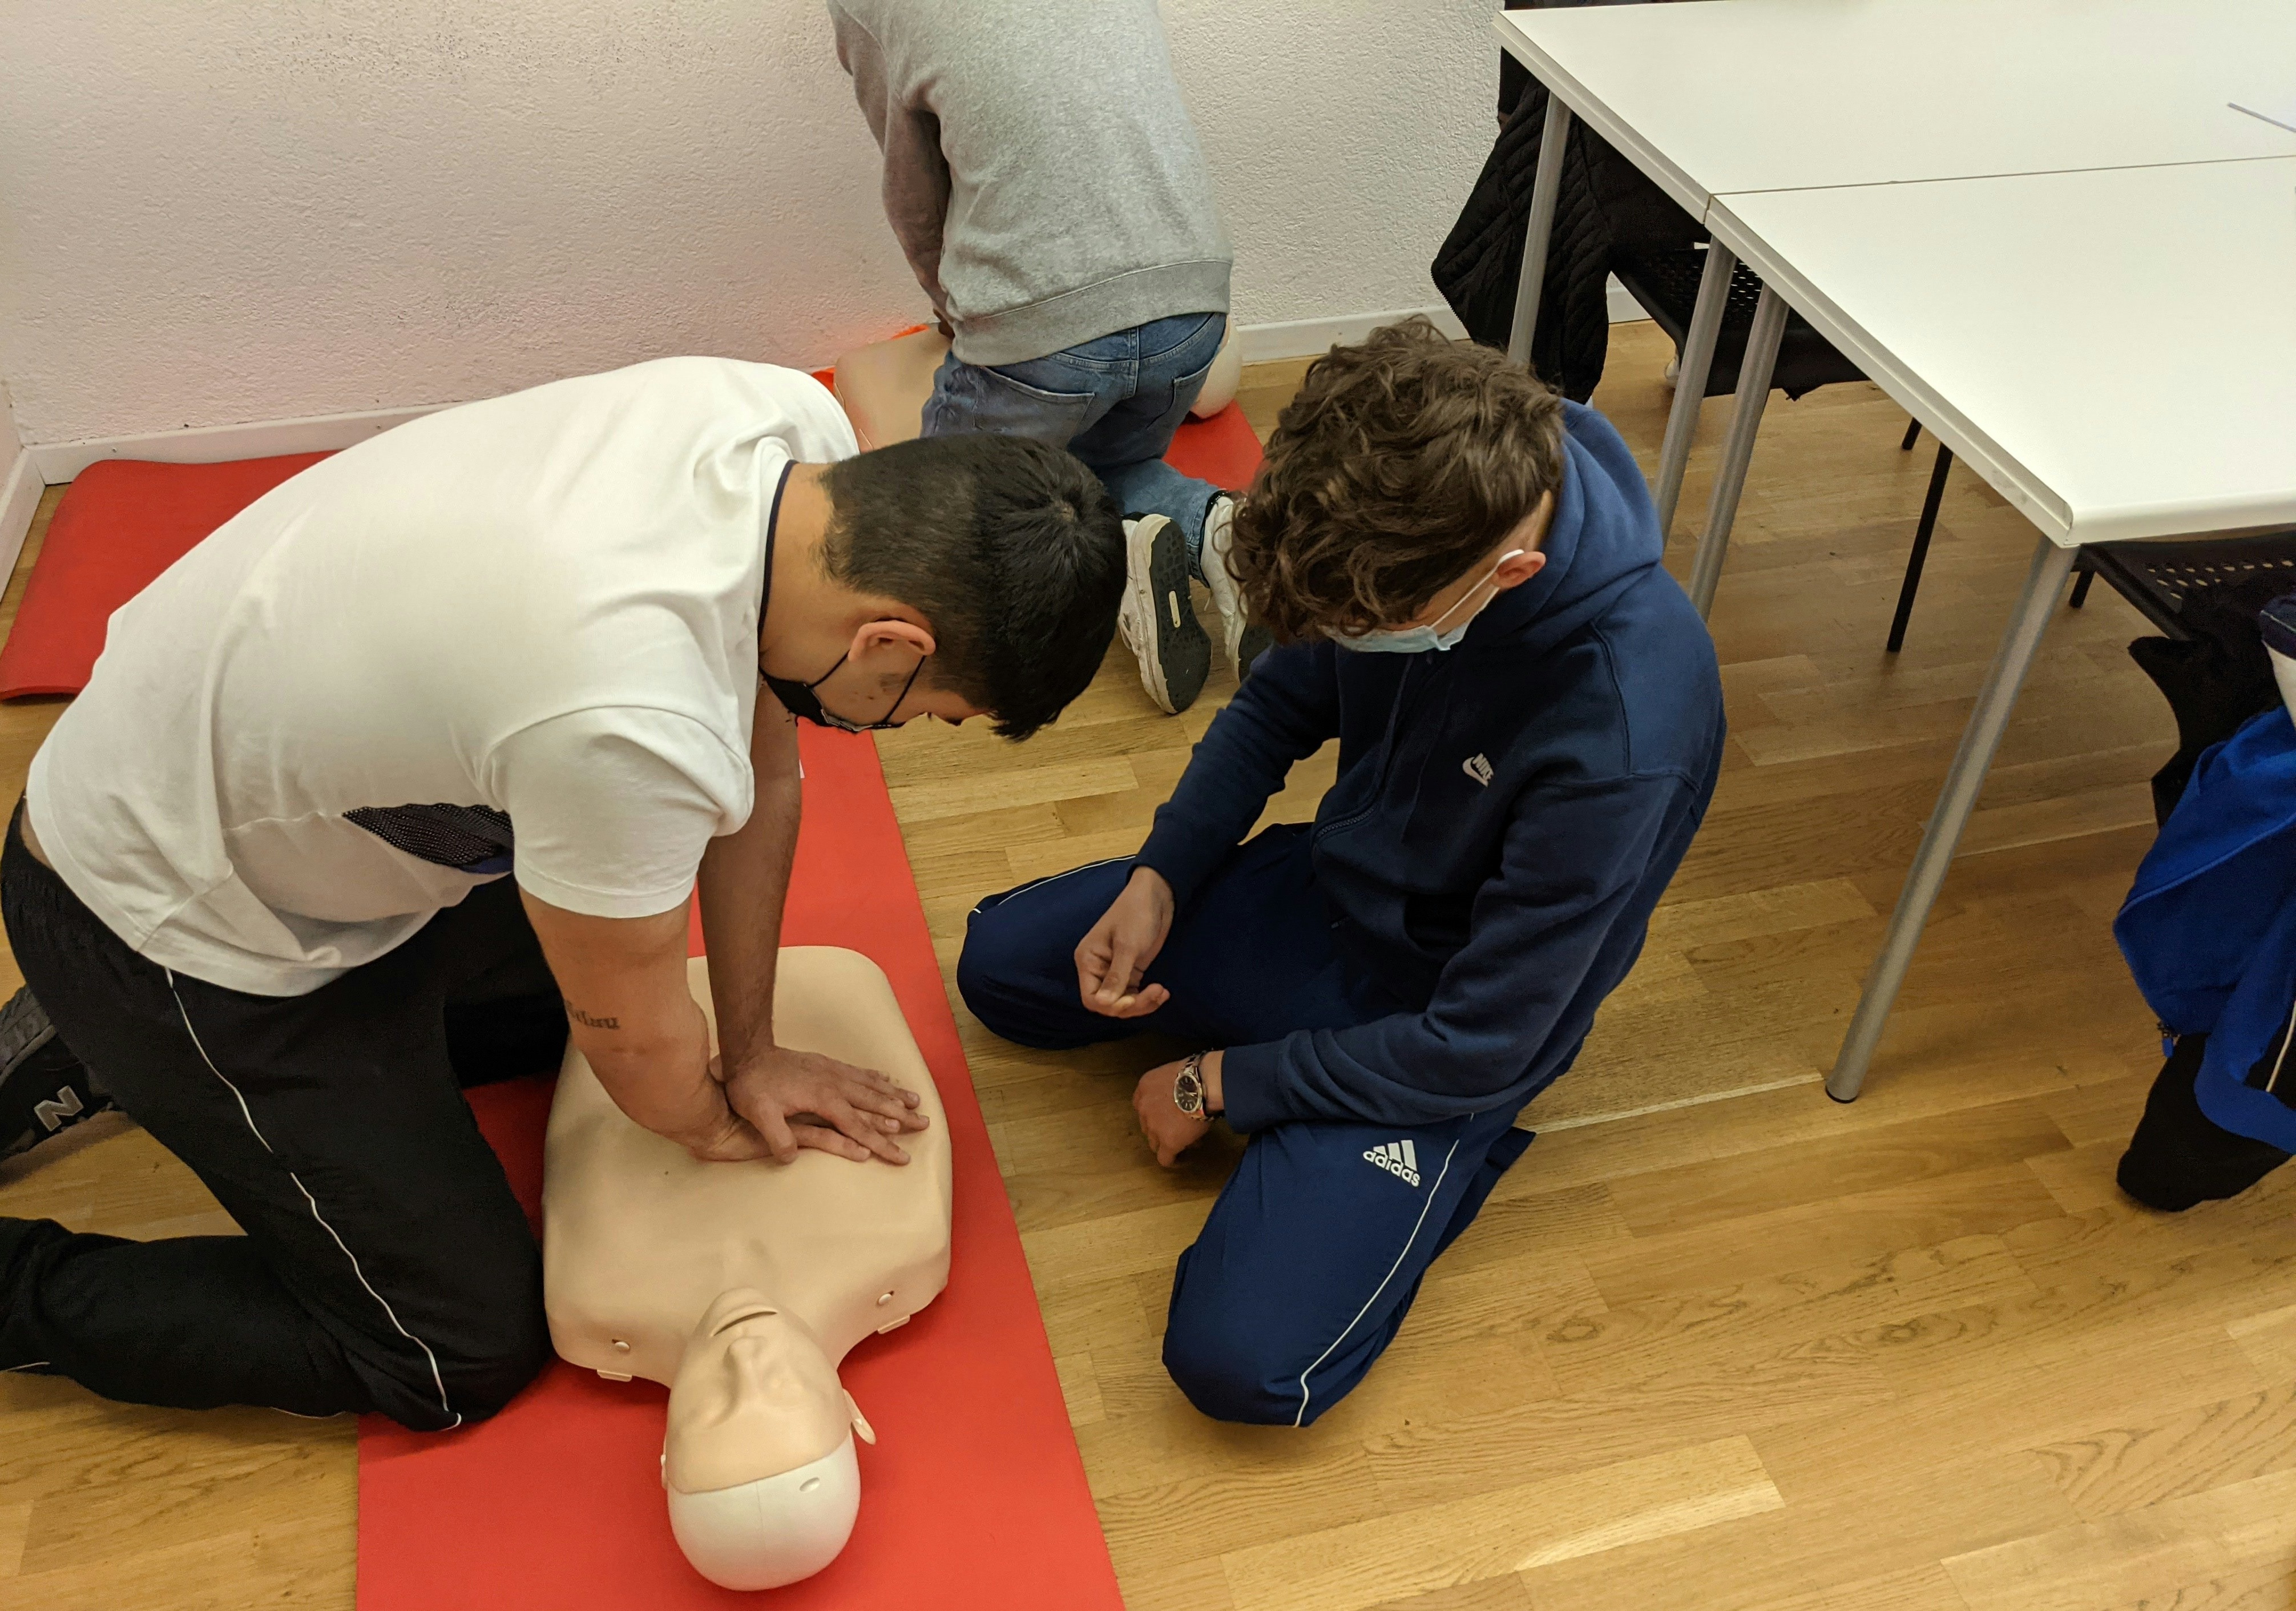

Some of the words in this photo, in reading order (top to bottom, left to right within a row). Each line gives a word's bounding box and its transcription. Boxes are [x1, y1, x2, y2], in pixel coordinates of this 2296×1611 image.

[1472, 752, 1494, 780] NIKE
[34, 1085, 84, 1131] N
[1363, 1151, 1420, 1187] adidas
